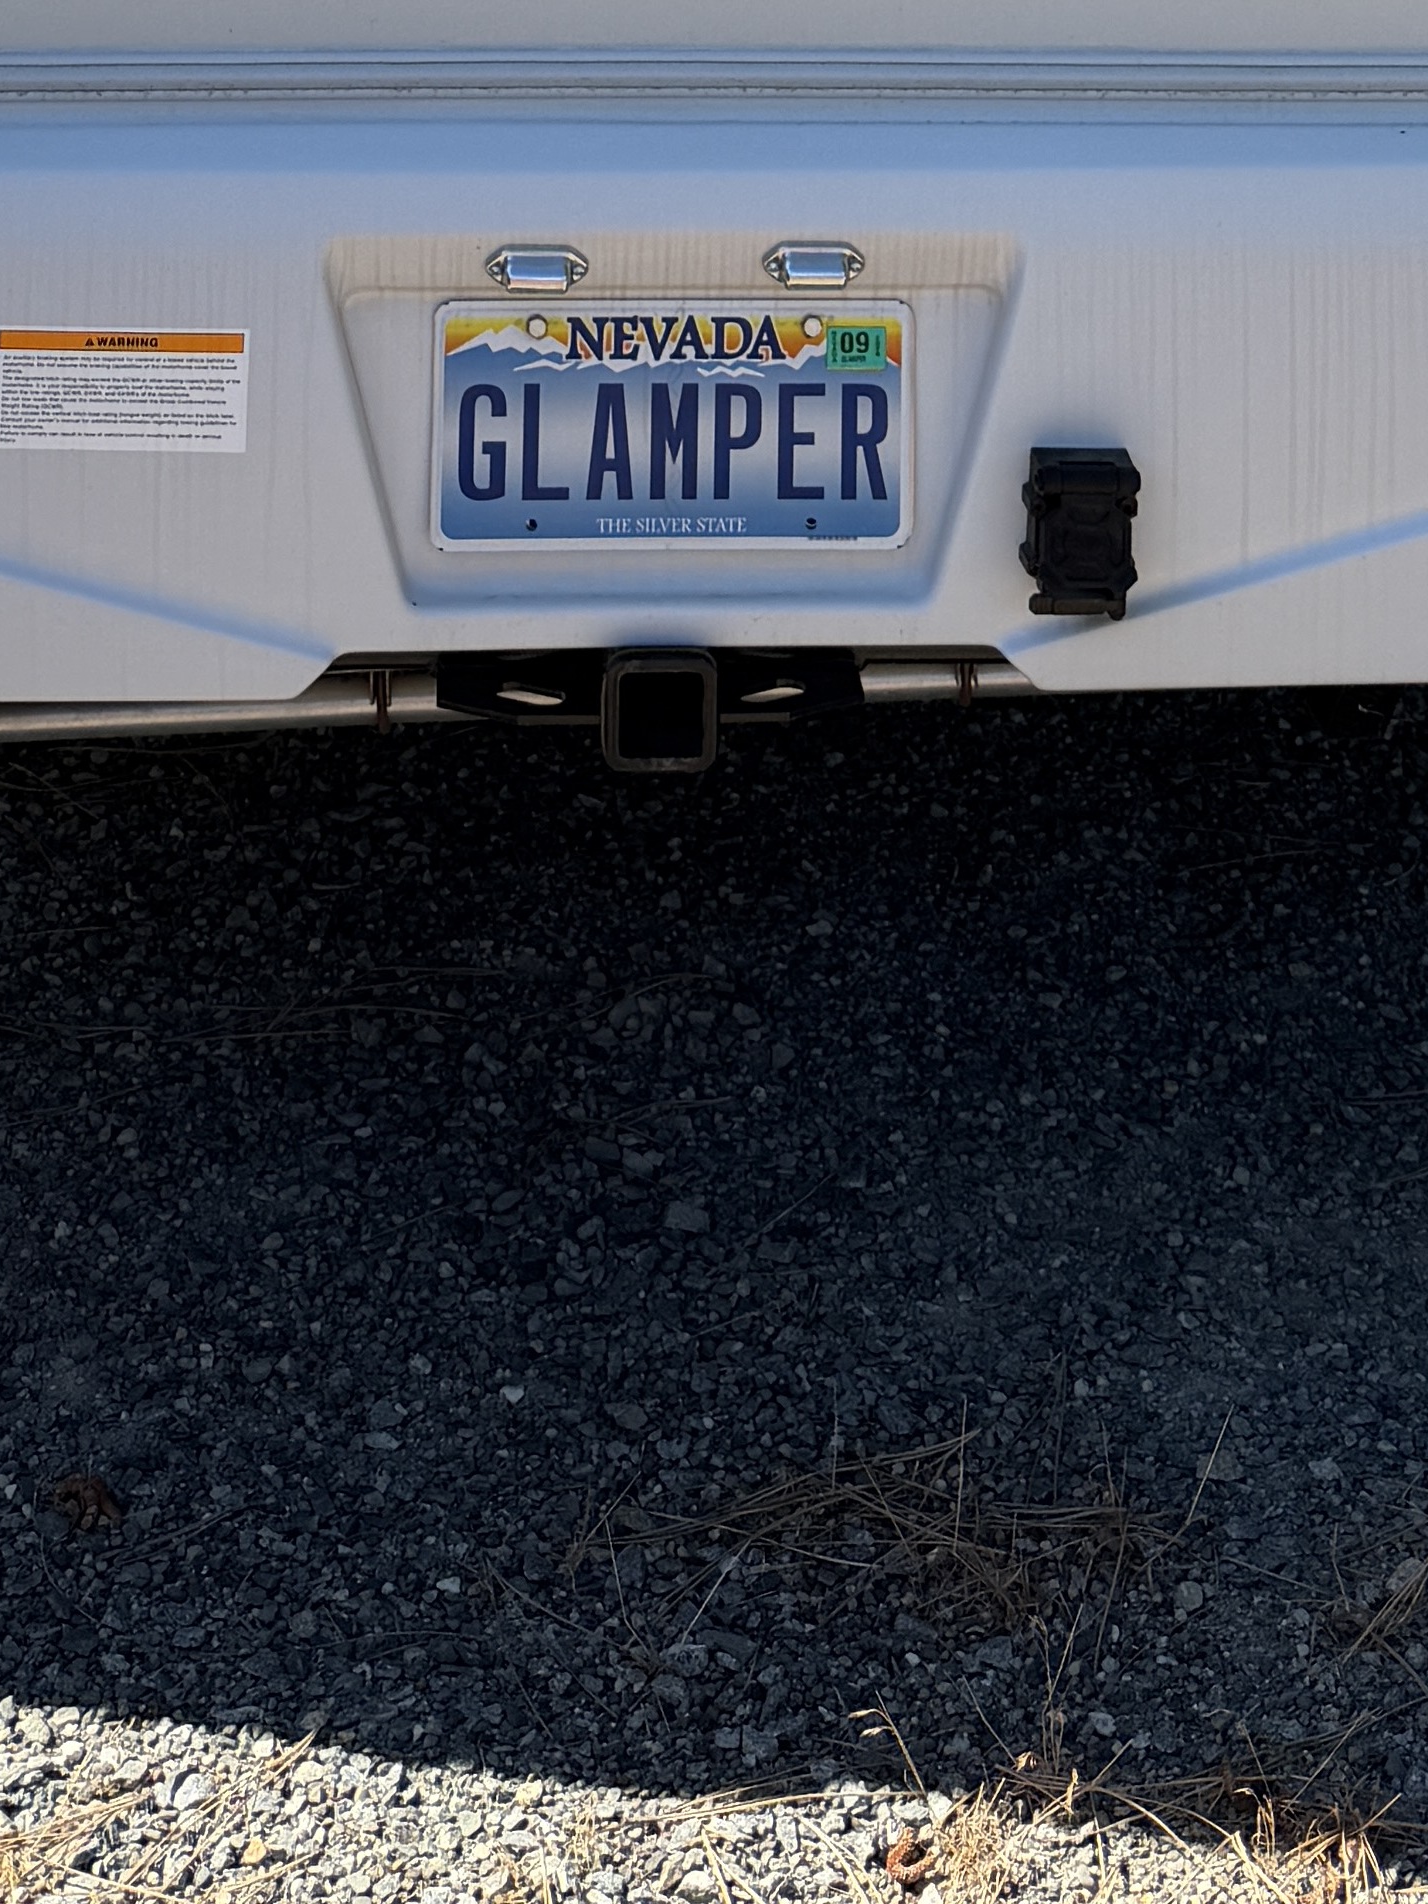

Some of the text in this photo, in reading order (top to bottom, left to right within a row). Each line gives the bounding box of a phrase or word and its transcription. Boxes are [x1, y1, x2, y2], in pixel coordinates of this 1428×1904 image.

[96, 337, 158, 348] WARNING
[565, 315, 786, 361] NEVADA
[840, 331, 869, 353] 09
[458, 383, 888, 501] GLAMPER
[597, 517, 747, 533] THE SILVER STATE
